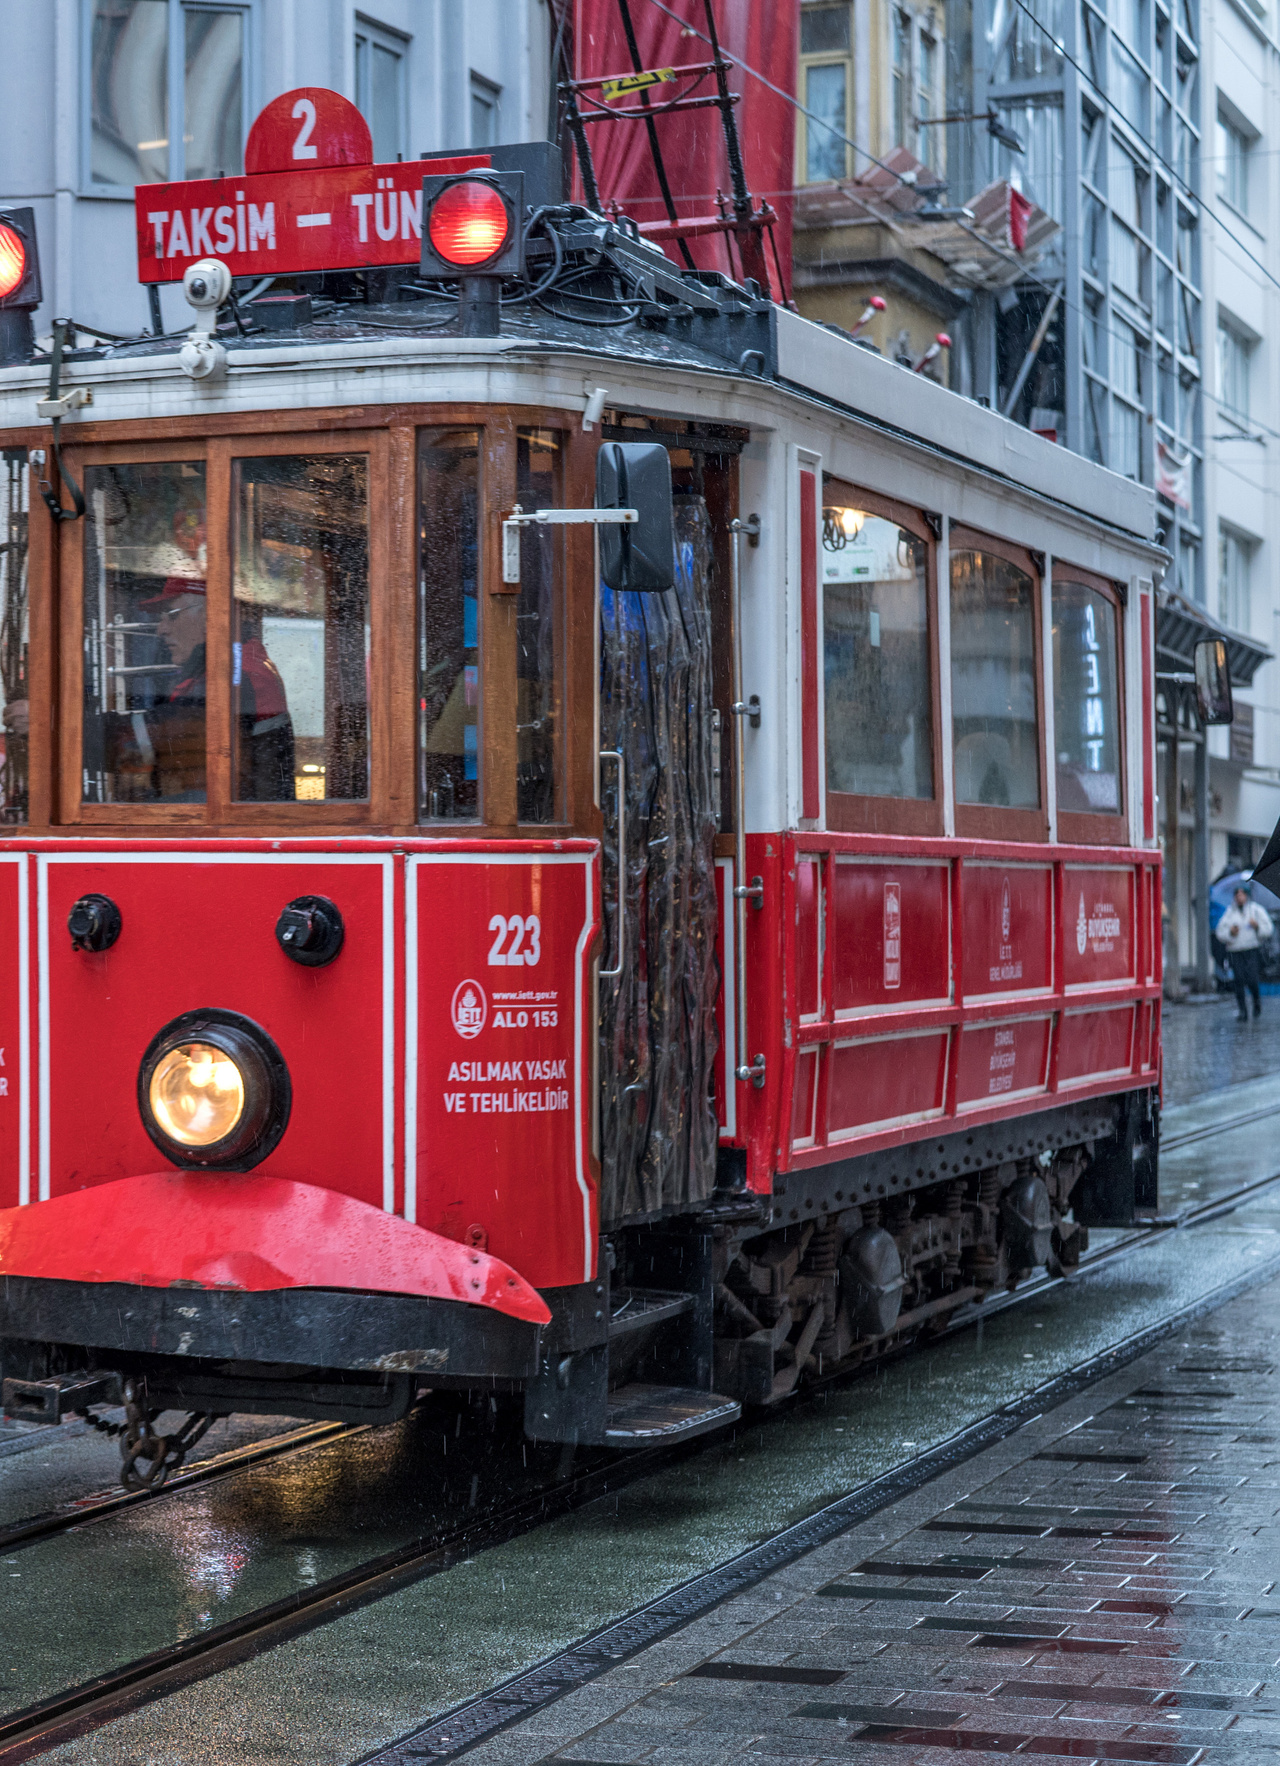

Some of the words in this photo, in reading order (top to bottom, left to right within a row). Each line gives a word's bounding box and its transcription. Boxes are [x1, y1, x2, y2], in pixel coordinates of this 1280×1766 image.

[292, 98, 318, 160] 2
[147, 190, 276, 259] TAKSİM
[487, 914, 541, 967] 223
[492, 1011, 529, 1028] ALO
[532, 1010, 559, 1028] 153
[447, 1061, 524, 1082] ASILMAK
[525, 1059, 568, 1081] YASAK
[443, 1092, 467, 1114] VE
[469, 1086, 570, 1114] TEHLİKELİDİR
